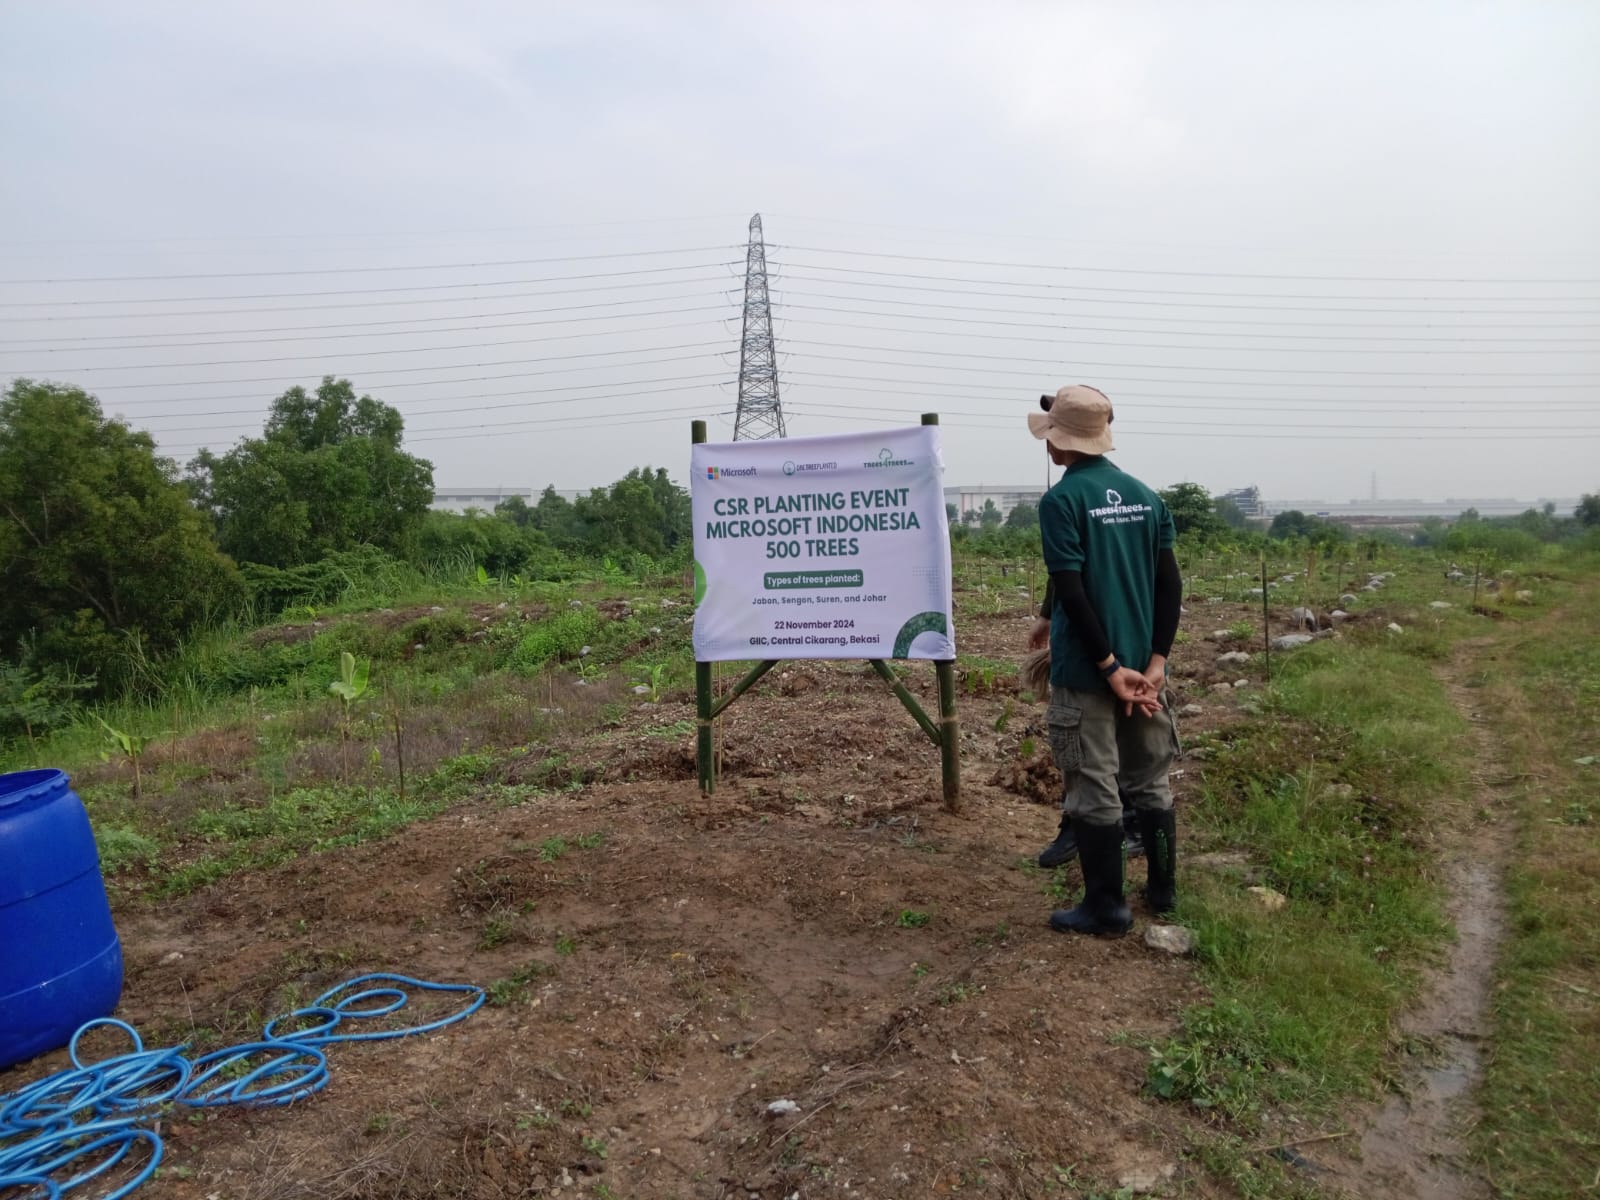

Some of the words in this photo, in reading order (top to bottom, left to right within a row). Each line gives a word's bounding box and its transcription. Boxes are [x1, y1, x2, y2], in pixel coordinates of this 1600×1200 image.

[720, 466, 757, 477] Microsoft
[714, 498, 748, 516] CSR
[754, 492, 846, 514] PLANTING
[850, 488, 910, 510] EVENT
[706, 517, 812, 539] MICROSOFT
[817, 512, 920, 534] INDONESIA
[766, 541, 800, 559] 500
[805, 538, 859, 557] TREES
[767, 576, 792, 586] Types
[793, 576, 802, 584] of
[802, 575, 823, 584] trees
[825, 574, 861, 585] planted:
[816, 596, 843, 604] Suren,
[844, 595, 860, 603] and
[862, 594, 887, 602] Johar
[774, 621, 784, 629] 22
[786, 620, 832, 629] November
[833, 620, 855, 628] 2024
[750, 637, 770, 646] GIIC,
[771, 636, 803, 645] Central
[805, 635, 848, 646] Cikarang,
[850, 634, 880, 644] Bekasi
